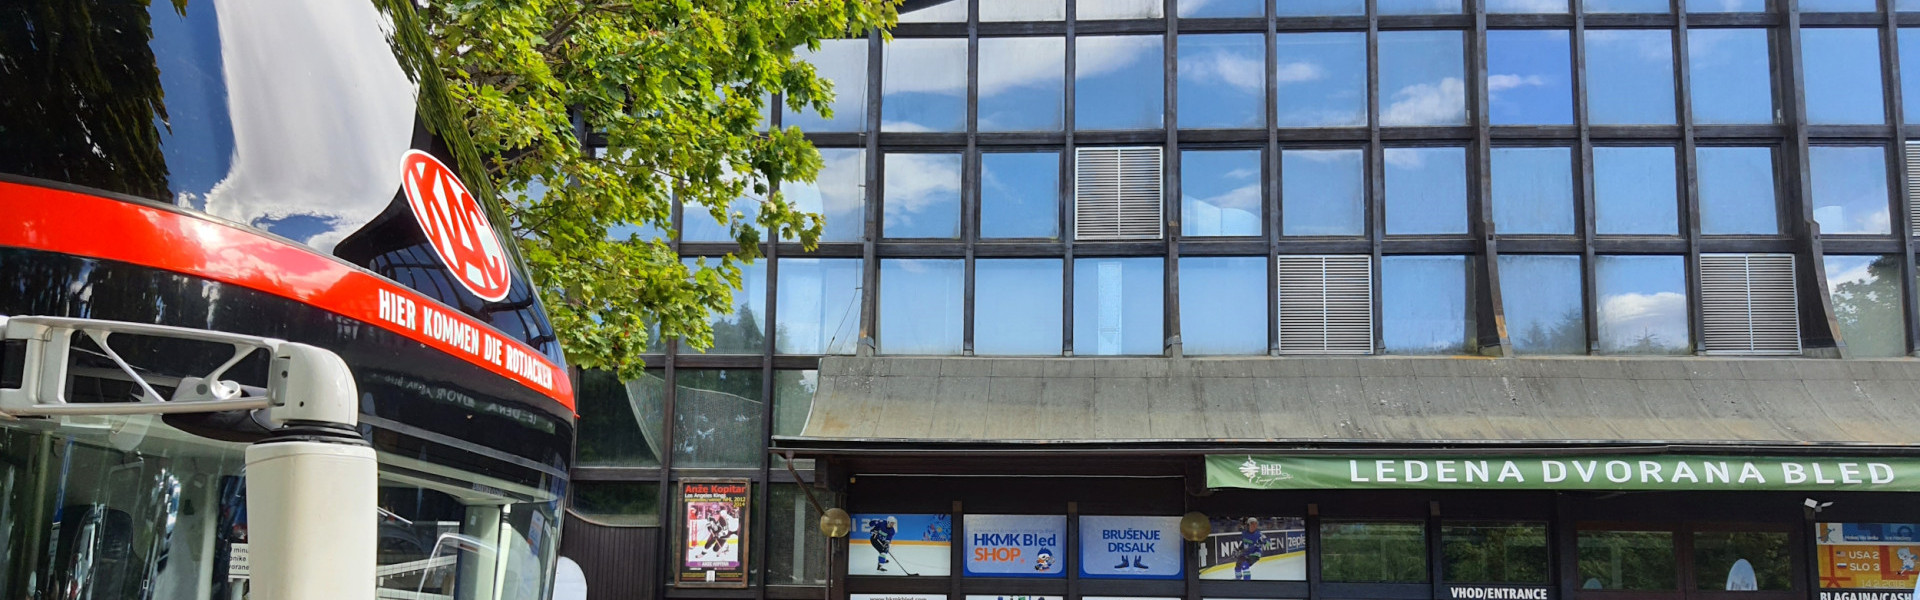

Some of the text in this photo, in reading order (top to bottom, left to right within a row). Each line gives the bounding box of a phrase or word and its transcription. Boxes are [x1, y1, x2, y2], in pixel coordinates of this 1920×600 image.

[404, 156, 507, 296] KAC
[378, 288, 553, 390] HIER KOMMEN DIE ROTJACKEN
[1350, 460, 1894, 484] LEDENA DVORANA BLED
[685, 484, 746, 494] Anže Kopitar
[974, 533, 1056, 546] HKMK Bled
[1102, 528, 1160, 540] BRUŠENJE
[1108, 542, 1155, 553] DRSALK
[1848, 551, 1879, 559] USA 2
[1850, 563, 1880, 571] SLO 3
[1450, 587, 1548, 599] VHOD/ENTRANCE
